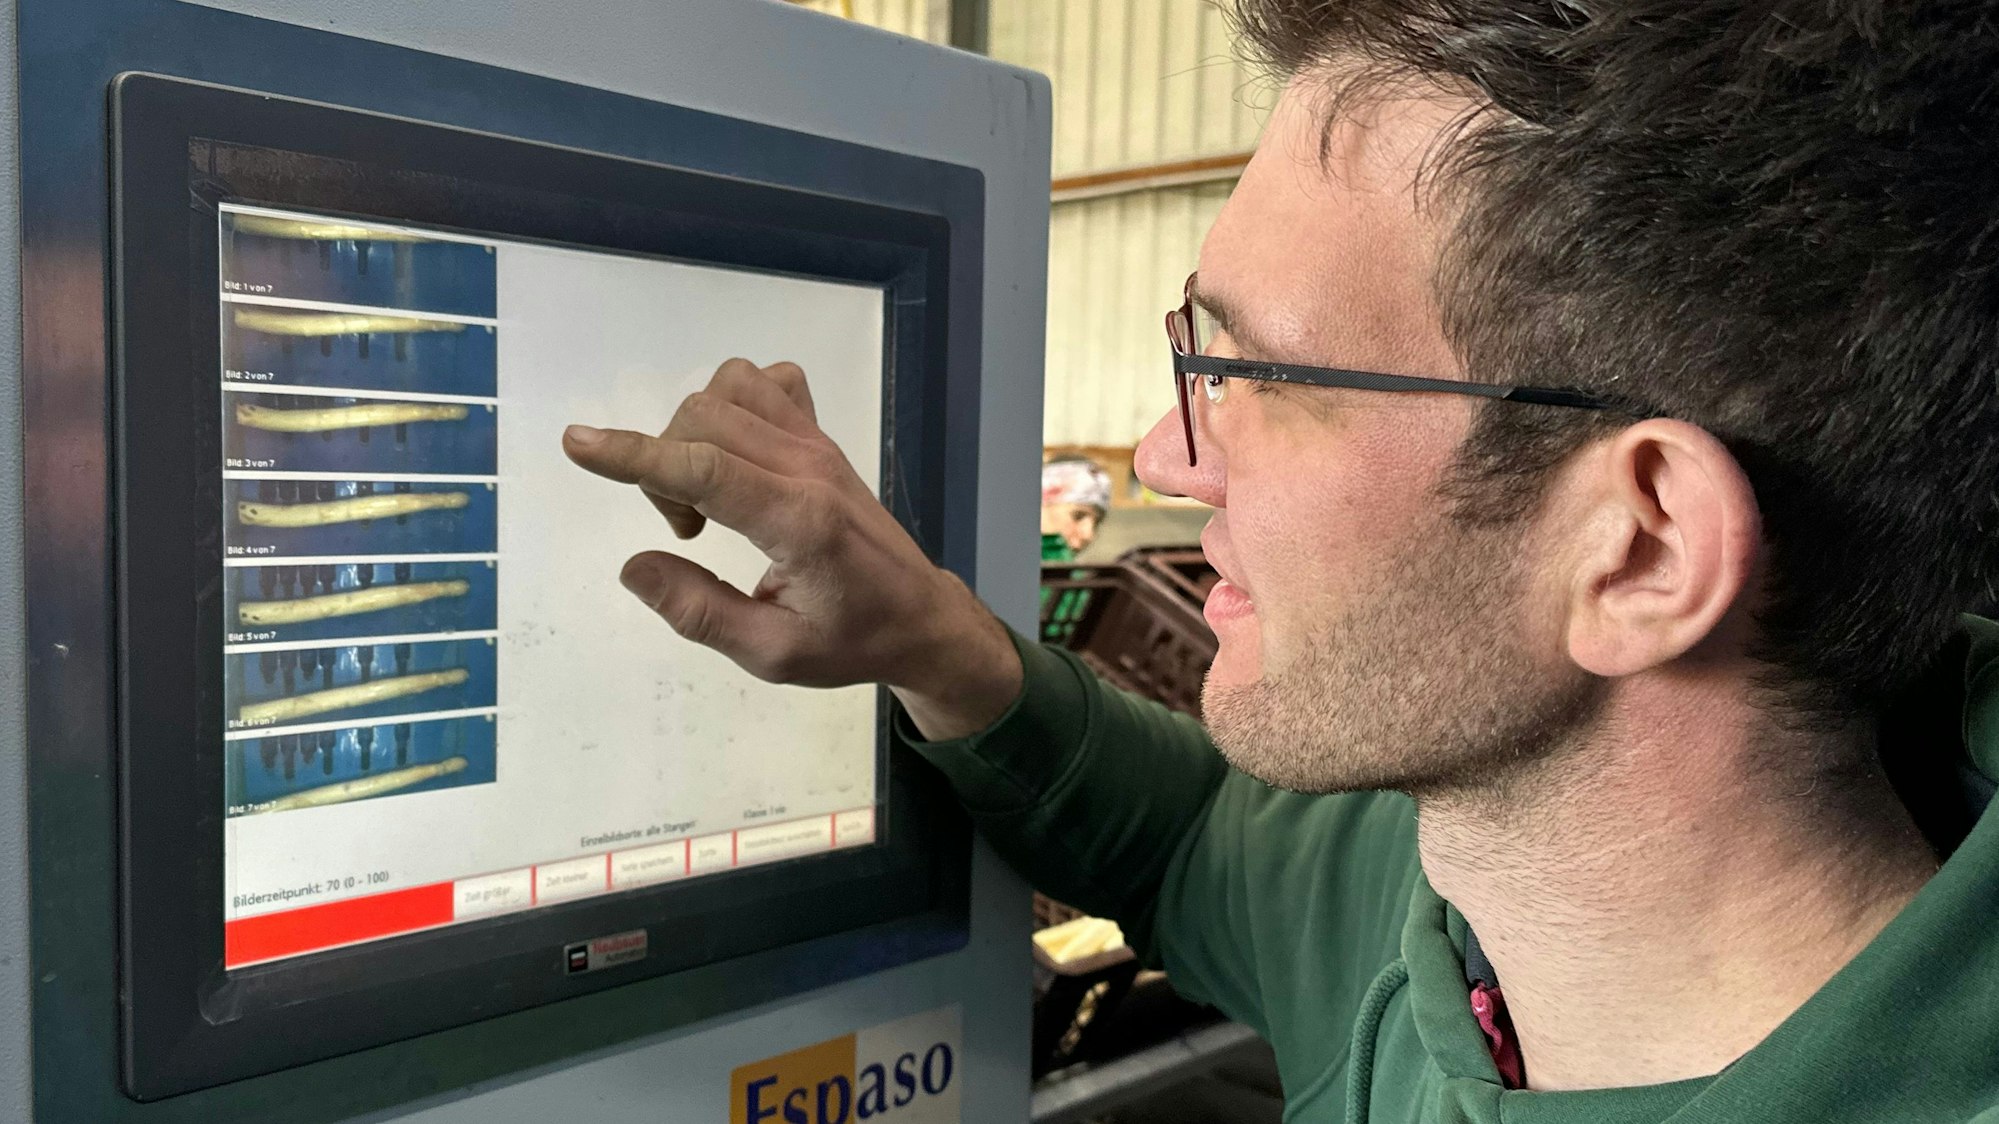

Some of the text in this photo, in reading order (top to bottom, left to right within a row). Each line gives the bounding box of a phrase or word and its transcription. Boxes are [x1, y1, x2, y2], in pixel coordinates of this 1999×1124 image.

[250, 285, 266, 293] von
[252, 460, 267, 468] von
[253, 546, 268, 554] von
[233, 884, 322, 908] Bilderzeitpunkt:
[326, 880, 340, 892] 70
[344, 876, 356, 890] (0
[367, 871, 390, 885] 100)
